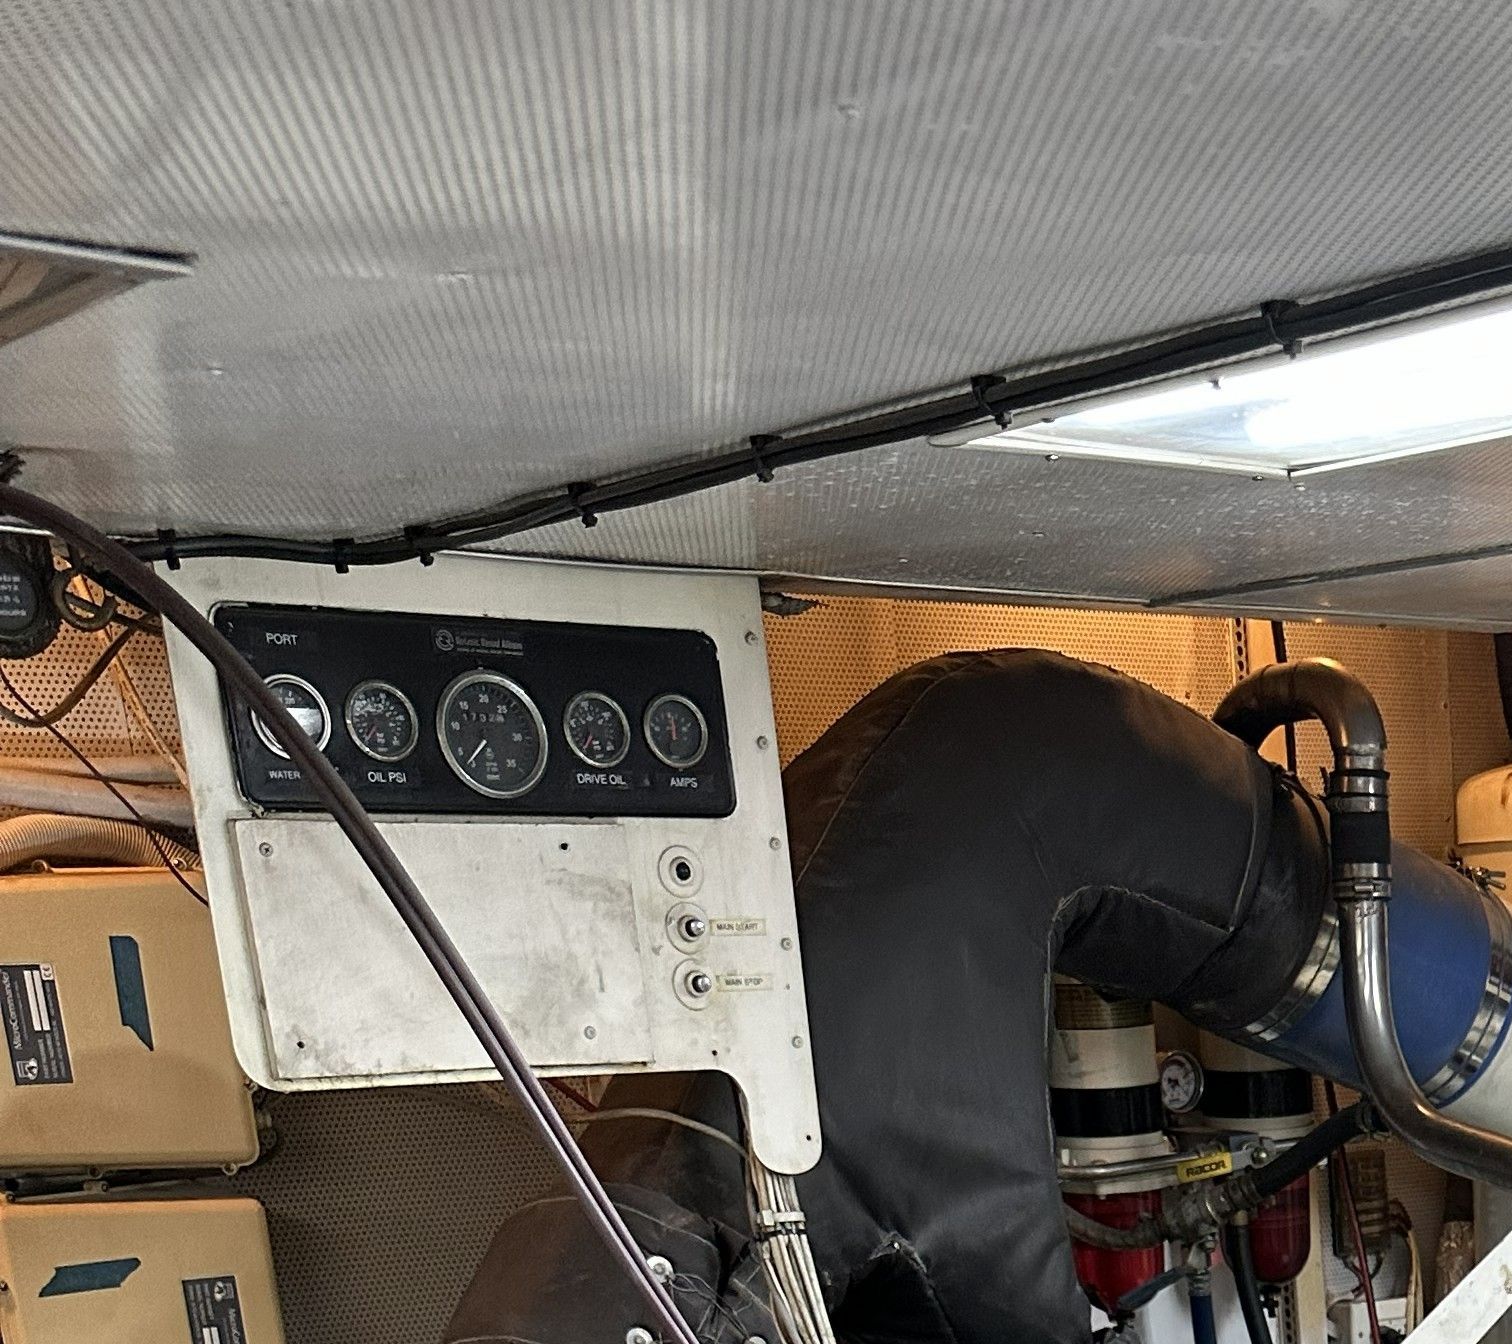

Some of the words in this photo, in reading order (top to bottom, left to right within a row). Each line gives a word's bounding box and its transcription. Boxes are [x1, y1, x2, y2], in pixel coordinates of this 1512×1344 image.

[265, 632, 298, 646] PORT
[269, 770, 301, 780] WATER
[367, 771, 387, 783] OIL
[388, 772, 407, 783] PSI
[576, 773, 607, 785] DRIVE
[609, 774, 627, 785] OIL
[670, 777, 698, 788] AMPS
